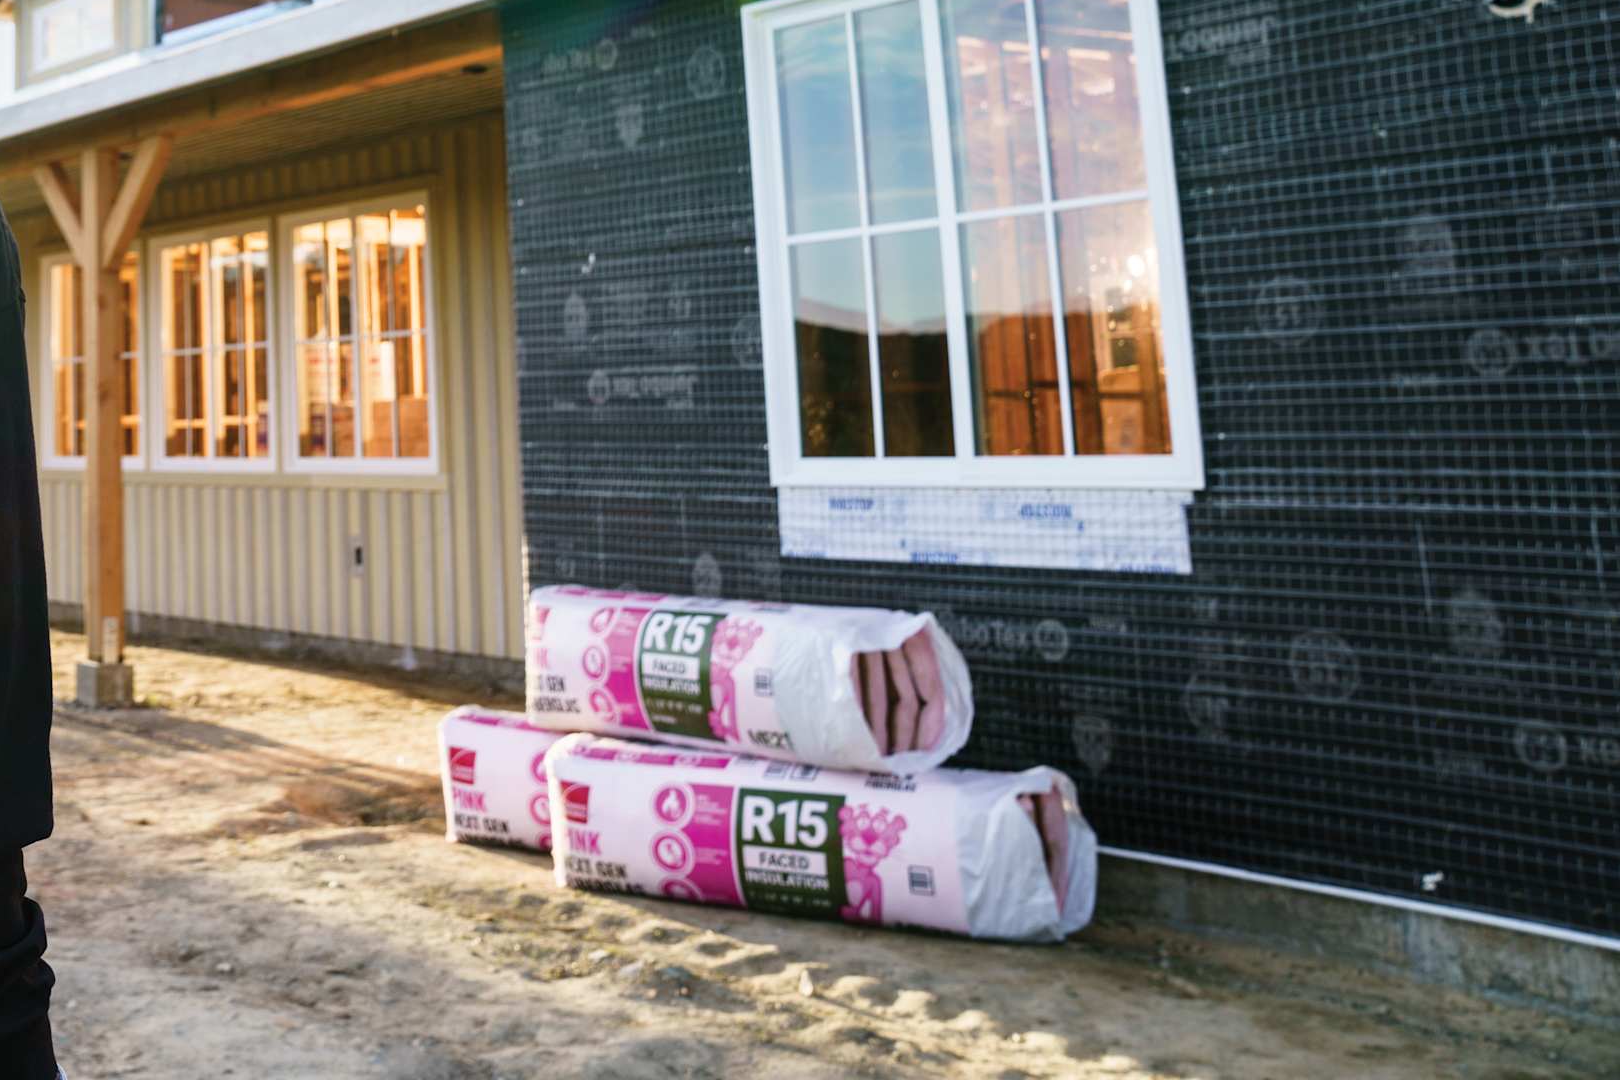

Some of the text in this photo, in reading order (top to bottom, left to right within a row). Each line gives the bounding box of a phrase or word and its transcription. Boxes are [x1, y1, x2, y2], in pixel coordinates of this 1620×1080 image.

[642, 610, 714, 655] R15
[651, 658, 689, 675] FACED
[452, 787, 487, 813] PINK
[741, 795, 829, 848] R15
[759, 851, 811, 870] FACED
[744, 870, 830, 891] INSULATION
